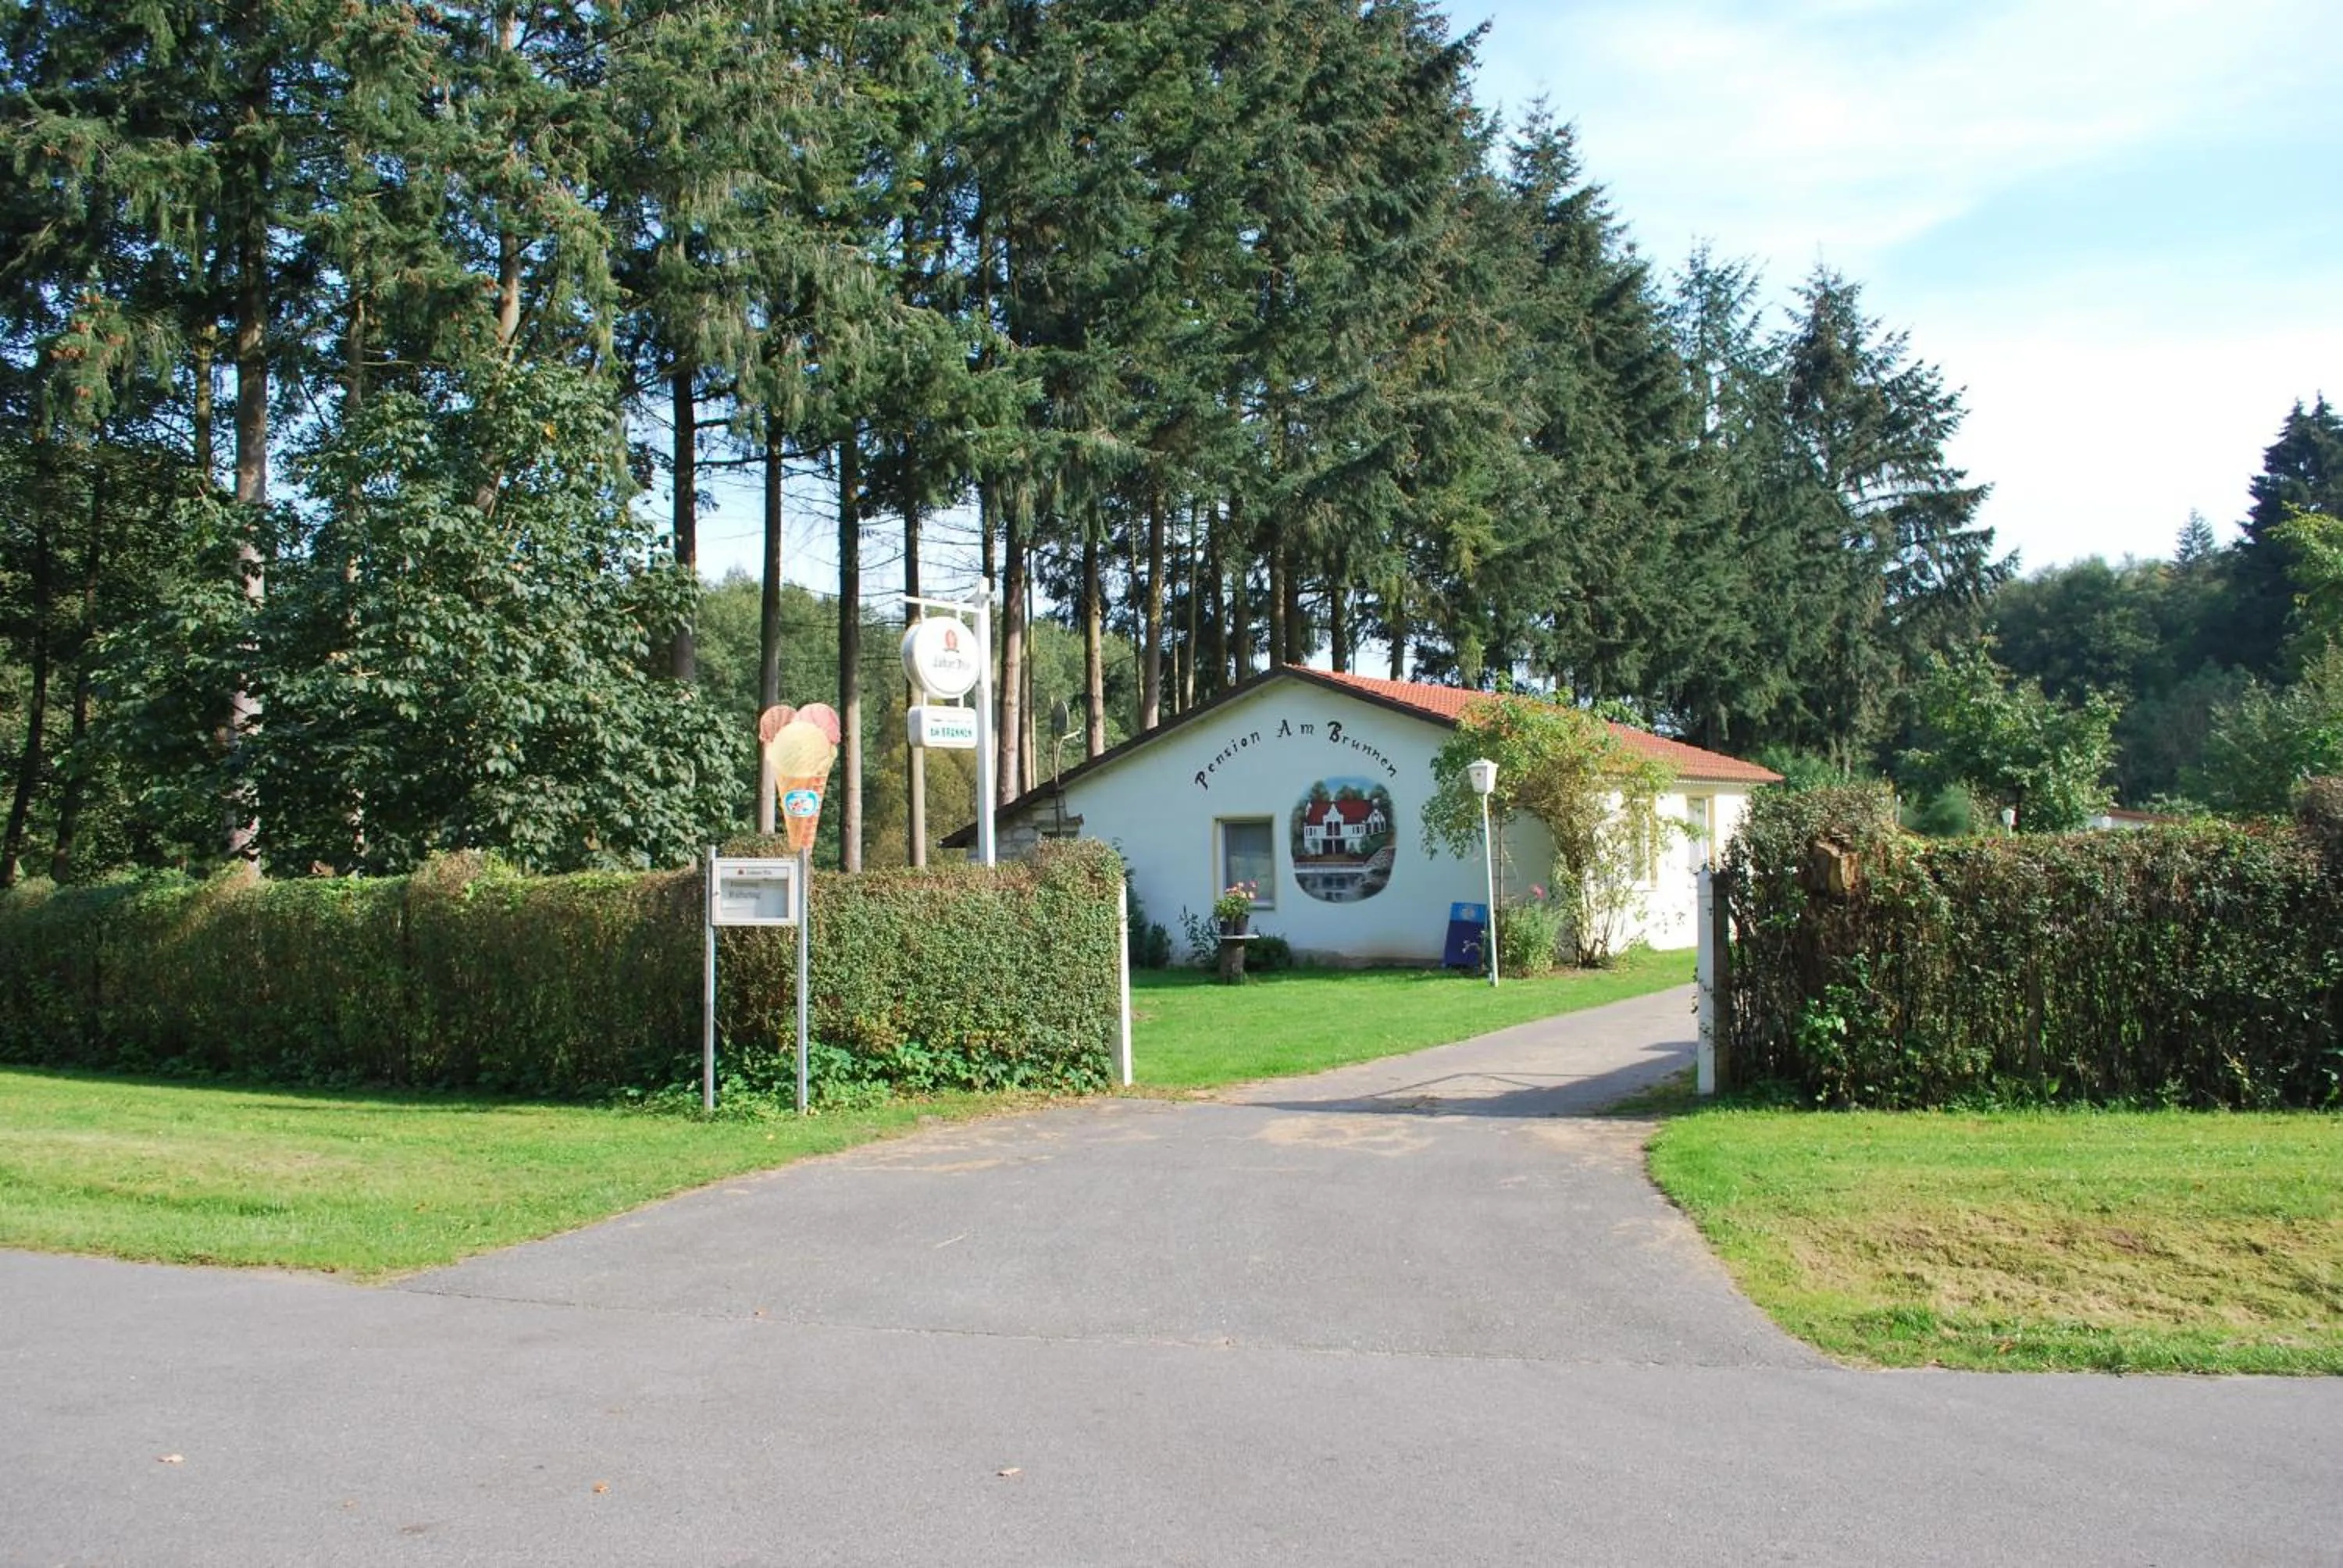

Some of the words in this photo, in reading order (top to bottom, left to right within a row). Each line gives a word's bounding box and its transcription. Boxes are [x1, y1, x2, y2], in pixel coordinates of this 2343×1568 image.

[1194, 731, 1261, 791] Pension
[1277, 718, 1315, 738] Am
[1327, 720, 1397, 778] Brunnen
